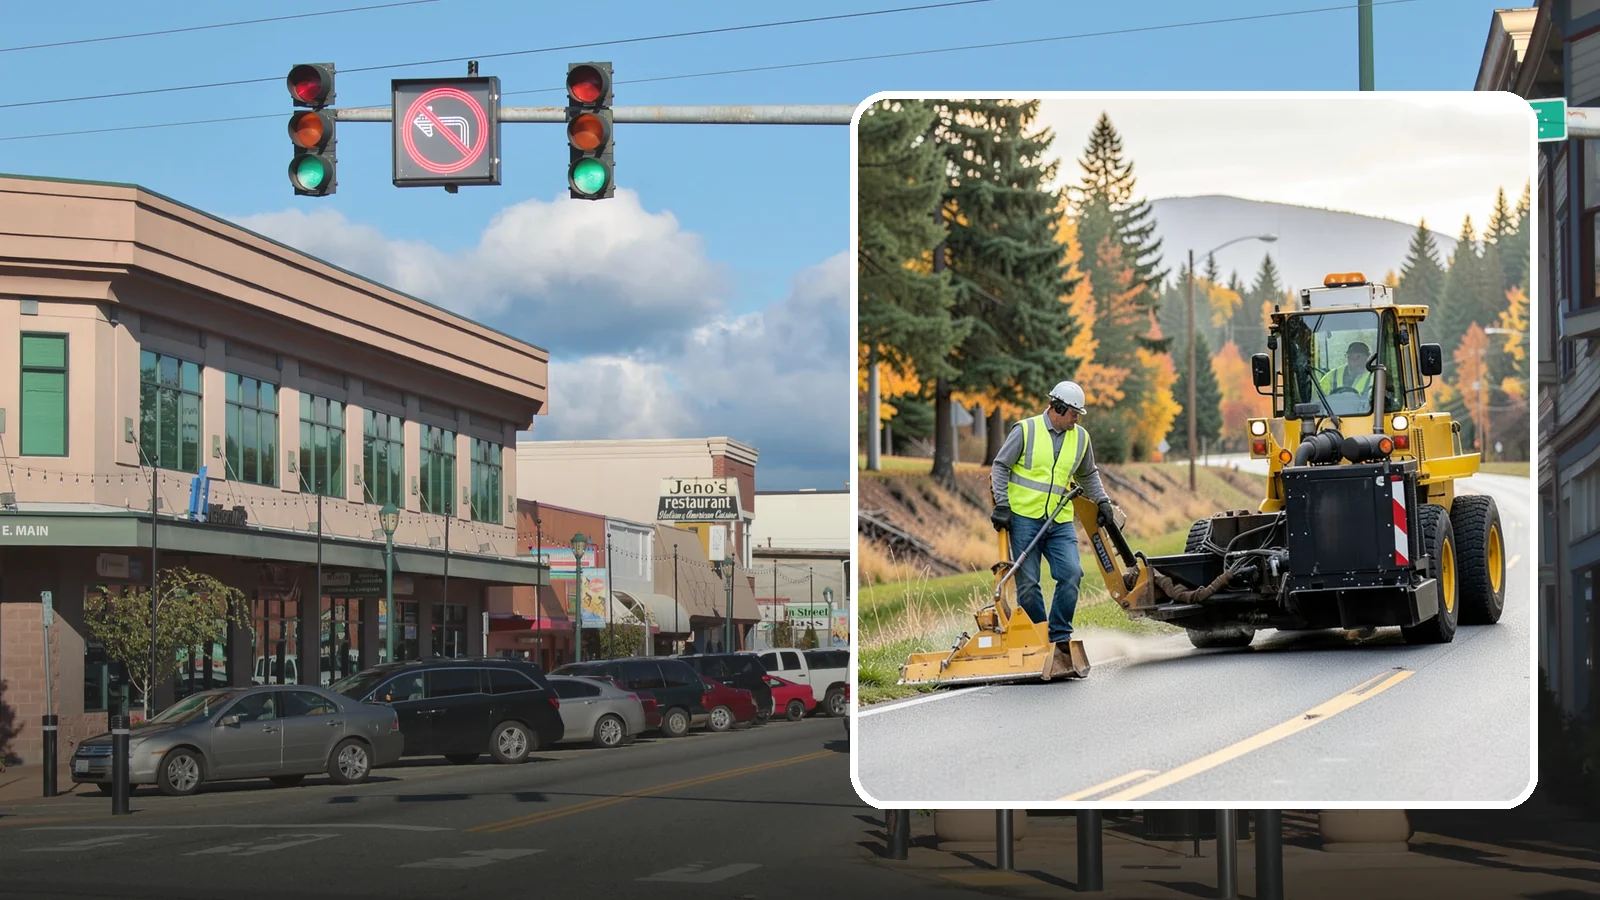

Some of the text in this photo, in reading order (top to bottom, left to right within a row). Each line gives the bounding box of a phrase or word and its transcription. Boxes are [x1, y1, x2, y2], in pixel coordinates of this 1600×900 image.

[669, 480, 728, 494] Jeno's
[665, 496, 731, 509] restaurant
[686, 510, 714, 519] American
[715, 510, 738, 519] Cuisine
[2, 525, 49, 536] E. MAIN
[797, 607, 828, 616] Street
